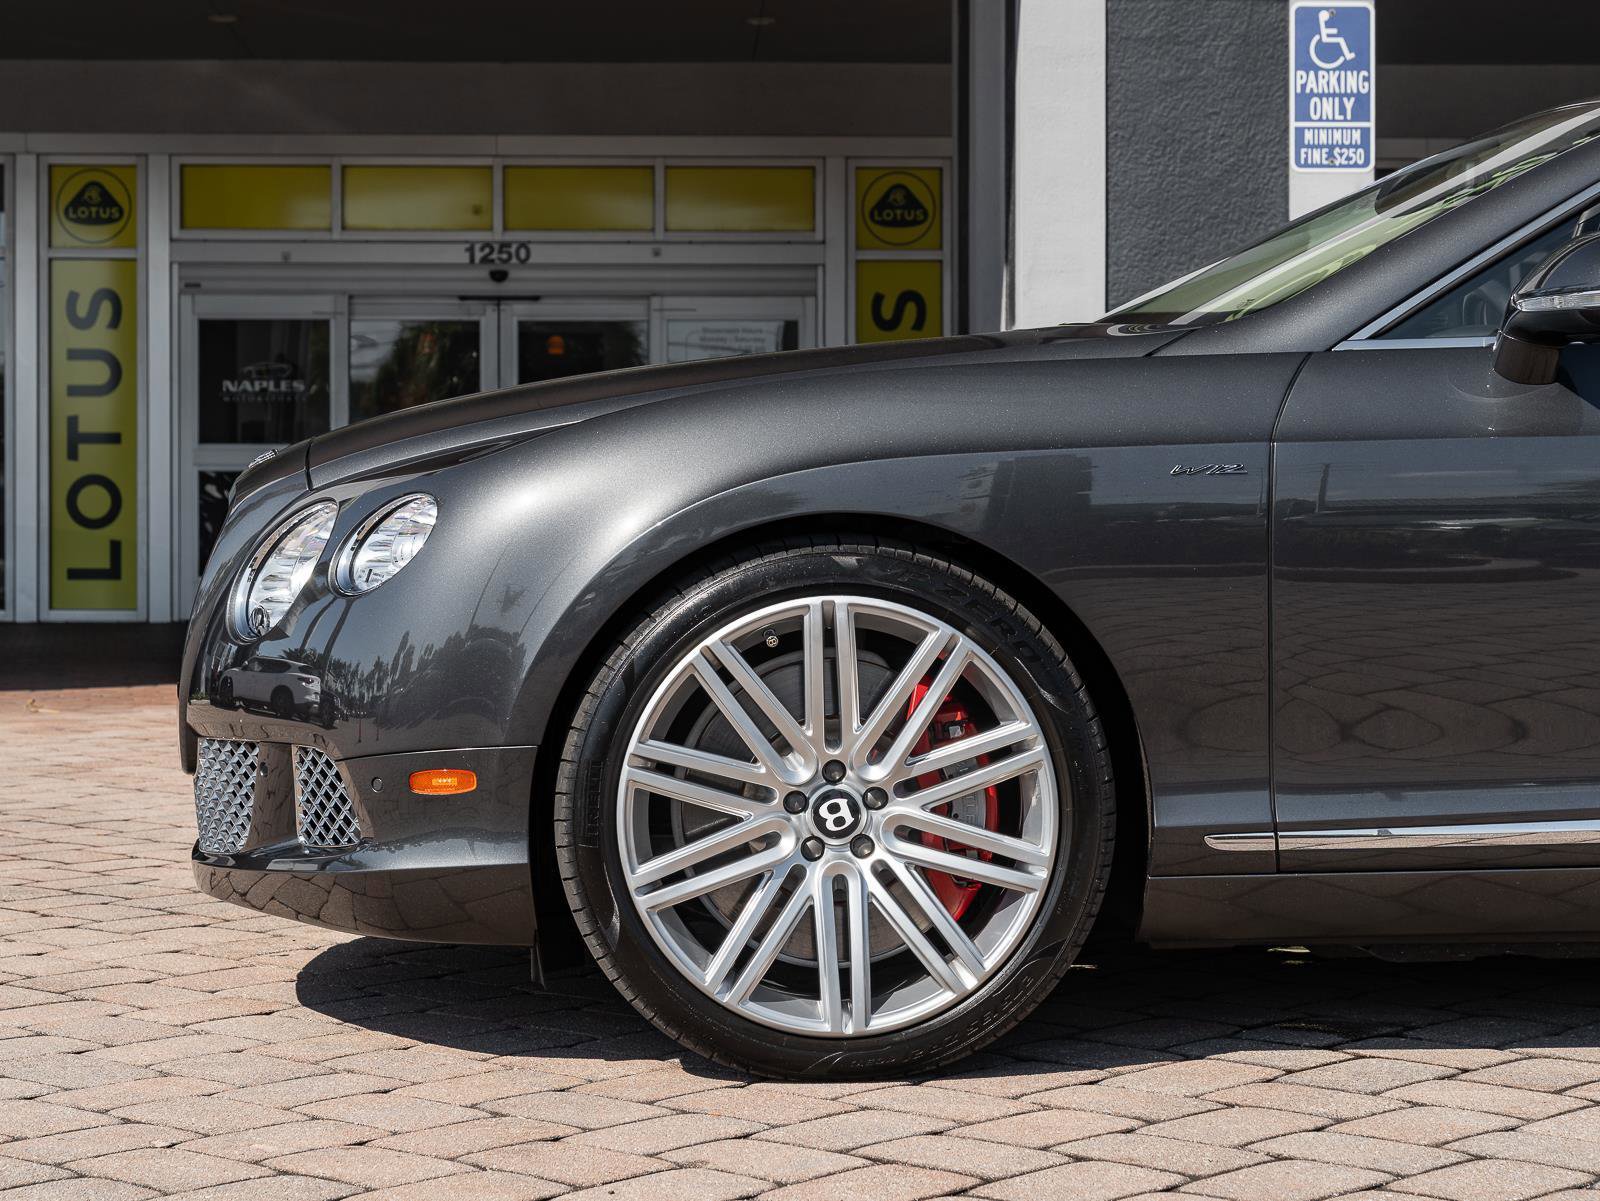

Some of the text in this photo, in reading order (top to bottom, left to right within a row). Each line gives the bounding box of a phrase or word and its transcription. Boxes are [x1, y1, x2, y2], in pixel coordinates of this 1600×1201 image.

[1296, 70, 1370, 94] PARKING
[1310, 97, 1356, 121] ONLY
[1304, 129, 1361, 145] MINIMUM
[1300, 147, 1365, 167] FINE $250
[68, 206, 120, 220] LOTUS
[873, 208, 925, 221] LOTUS
[464, 242, 531, 265] 1250
[222, 379, 306, 393] NAPLES
[65, 287, 123, 581] LOTUS
